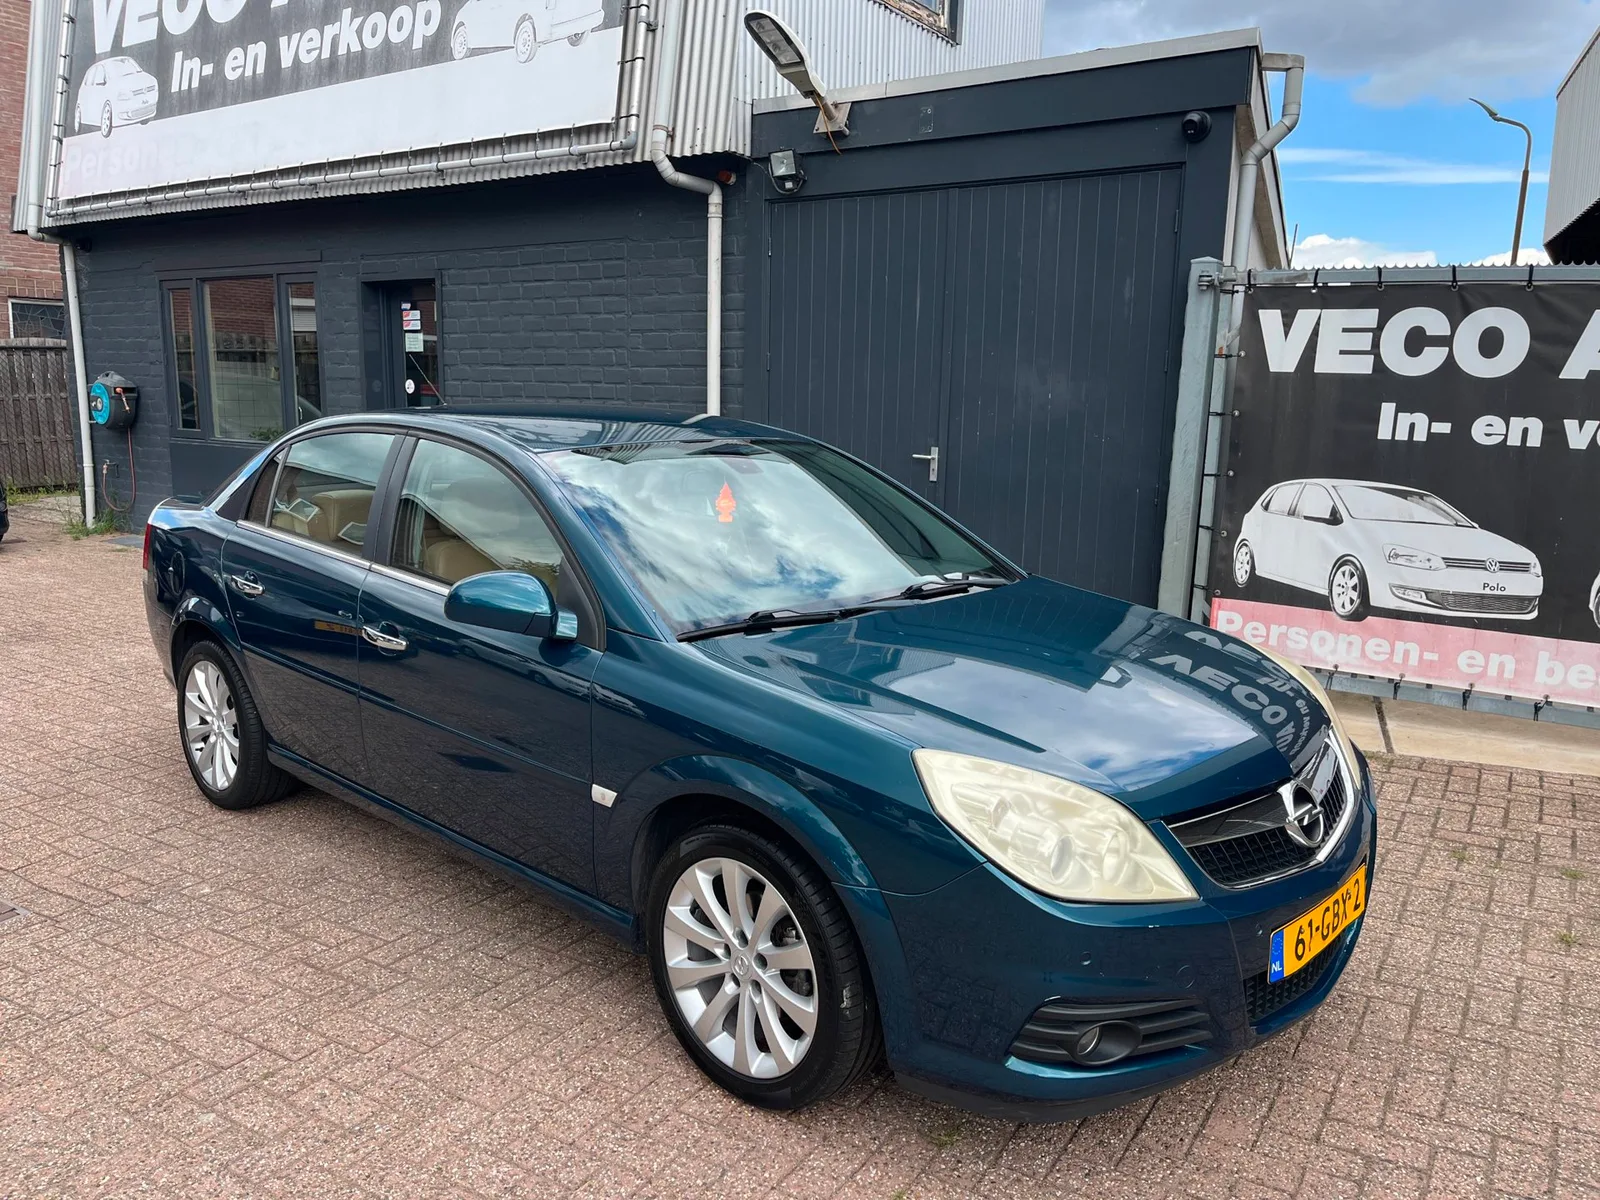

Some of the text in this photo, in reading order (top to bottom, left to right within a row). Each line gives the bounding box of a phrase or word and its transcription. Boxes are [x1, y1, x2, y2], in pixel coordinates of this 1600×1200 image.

[171, 0, 441, 93] In- en verkoop
[1258, 306, 1531, 378] VECO
[1377, 402, 1600, 450] In- en v
[1482, 582, 1506, 592] Polo
[1216, 610, 1439, 667] Personen-
[1457, 649, 1515, 679] en
[1294, 877, 1362, 962] 61-GBX-2
[1271, 961, 1283, 974] NL
